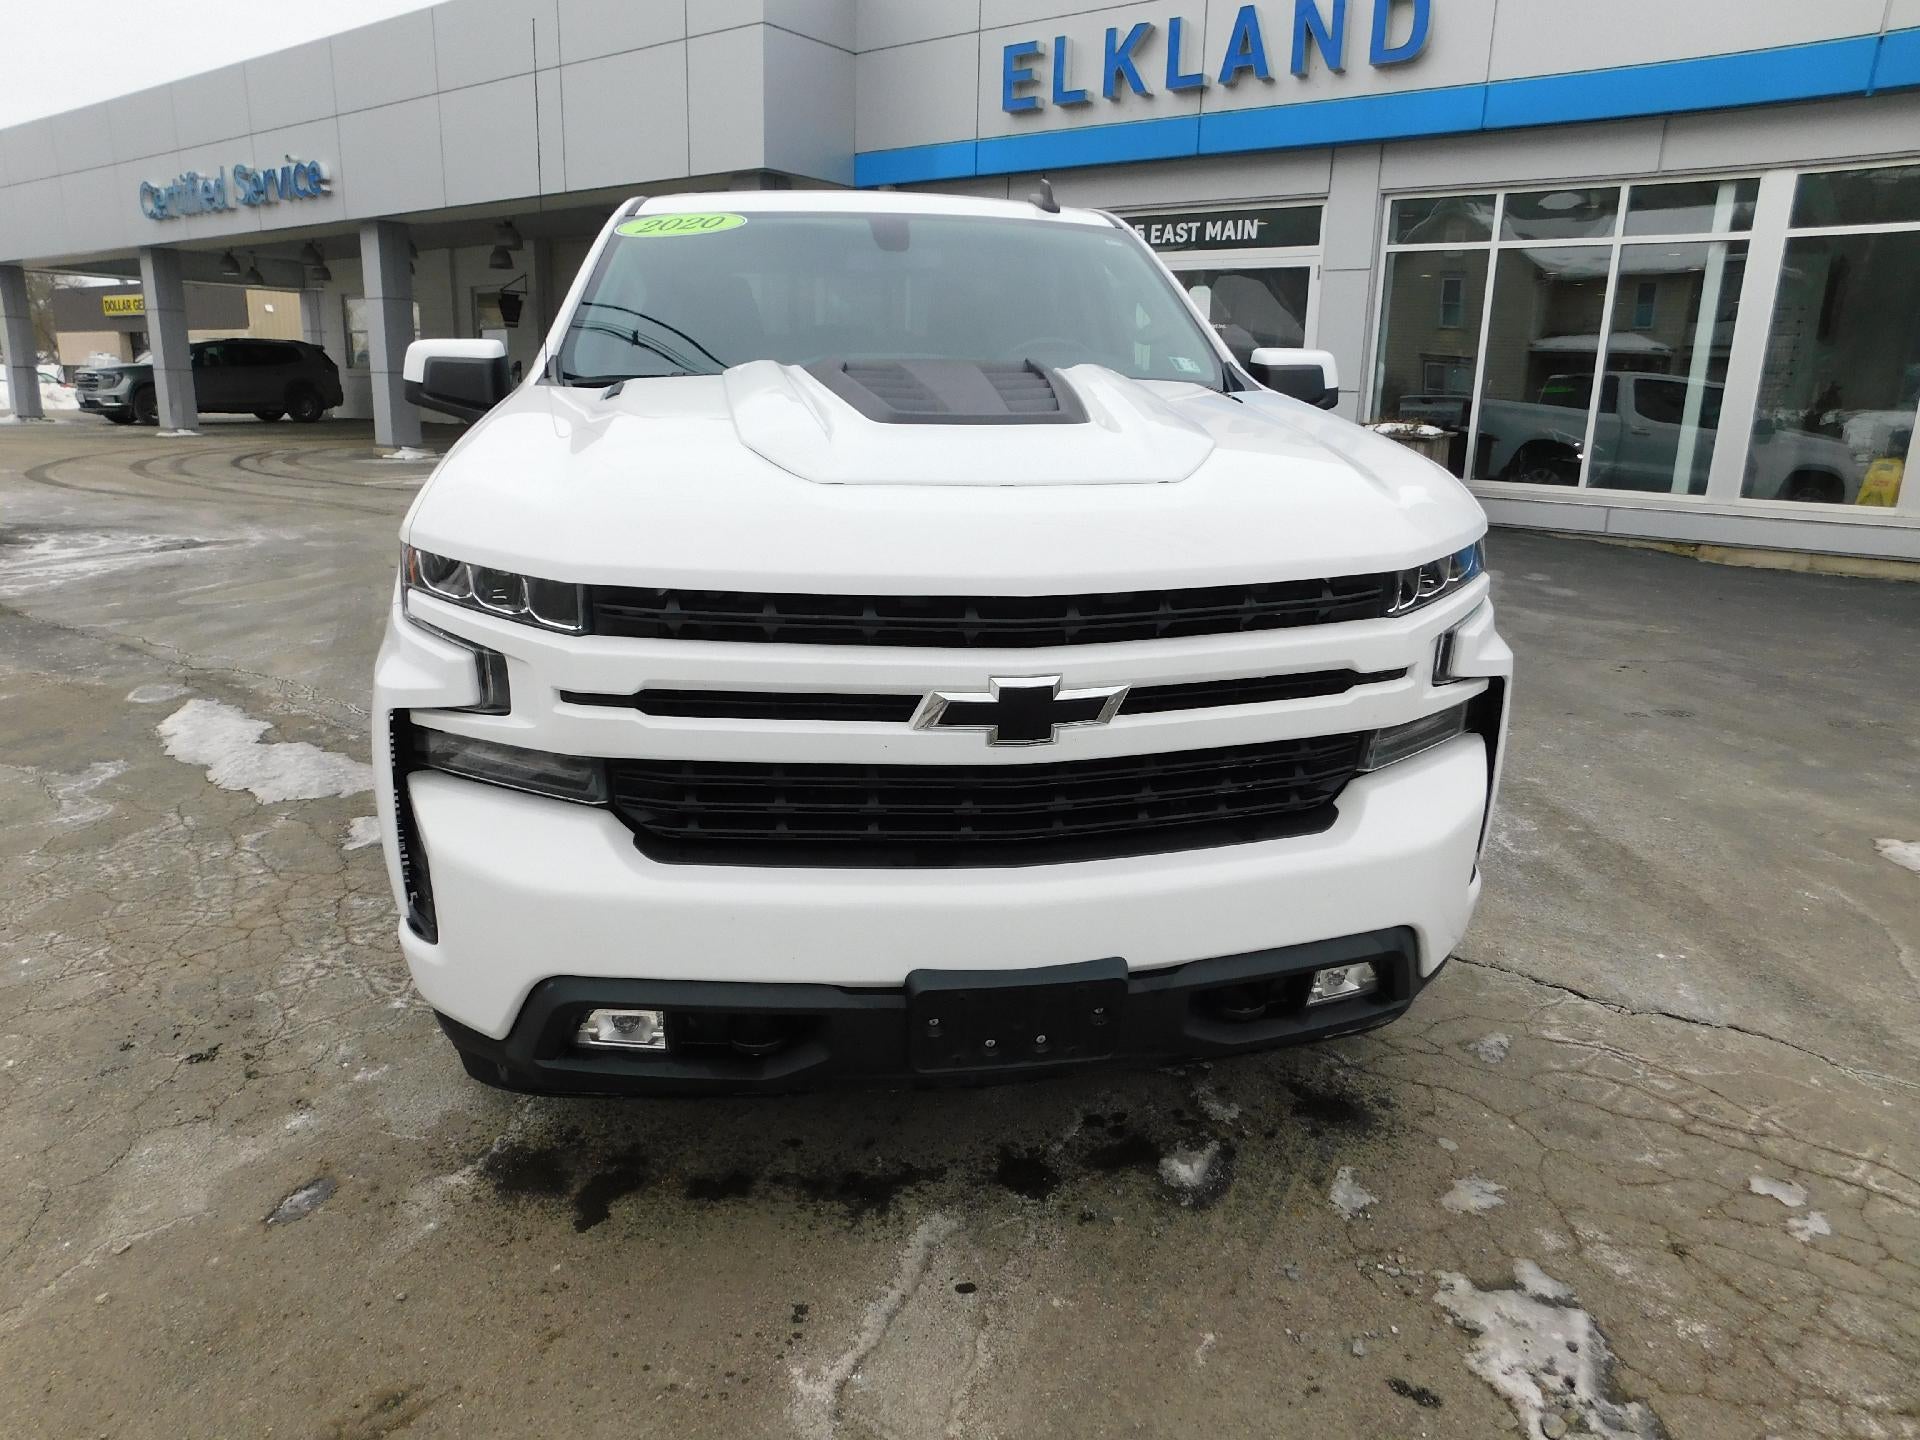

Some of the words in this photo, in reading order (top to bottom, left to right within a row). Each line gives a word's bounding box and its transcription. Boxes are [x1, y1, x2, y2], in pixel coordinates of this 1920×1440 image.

[1002, 0, 1434, 112] ELKLAND
[140, 166, 226, 219] Certified
[234, 160, 322, 205] Service
[635, 216, 726, 234] 2020
[1150, 222, 1200, 244] EAST
[1205, 219, 1258, 241] MAIN
[105, 299, 131, 312] DOLLAR
